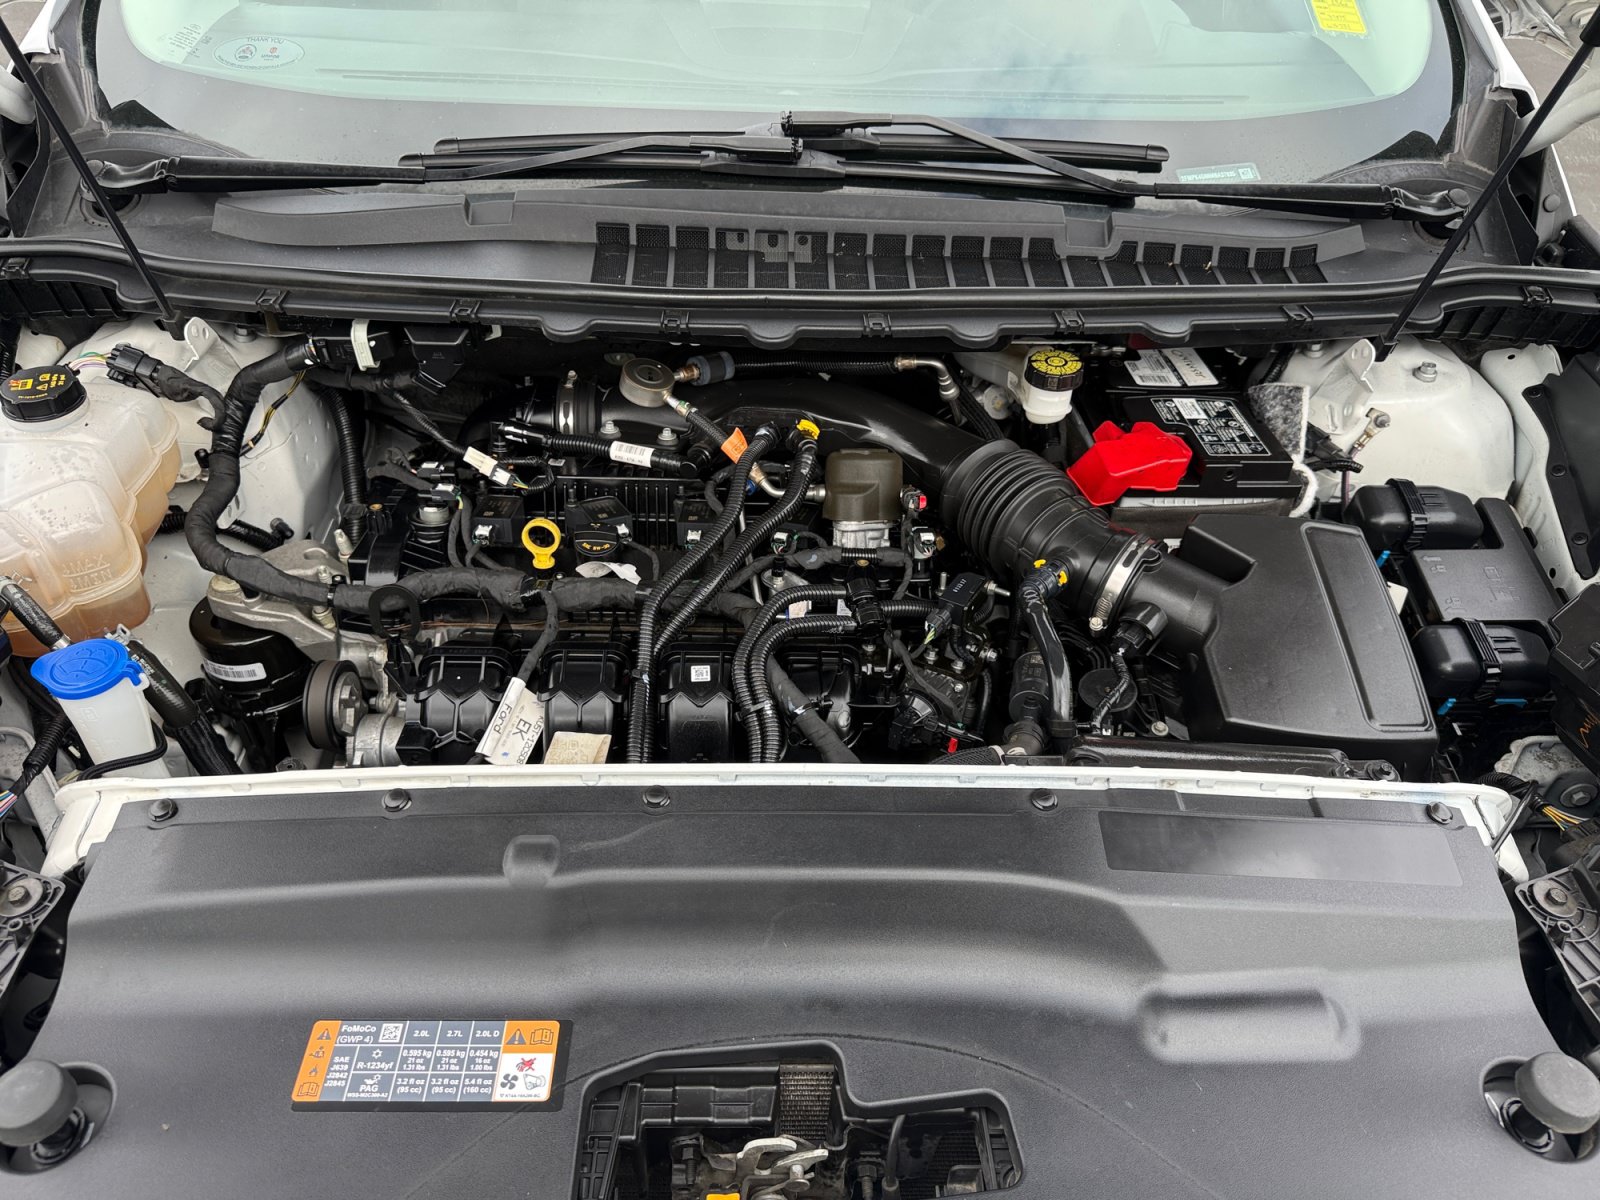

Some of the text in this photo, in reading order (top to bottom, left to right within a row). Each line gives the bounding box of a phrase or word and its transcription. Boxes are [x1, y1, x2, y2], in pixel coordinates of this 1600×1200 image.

[70, 554, 107, 574] MAX
[77, 568, 112, 589] MIN
[494, 703, 512, 734] Ford
[512, 718, 532, 742] EK
[337, 1035, 373, 1044] (GWP 4)
[402, 1049, 432, 1058] 0.595 kg
[436, 1049, 465, 1058] 0.595 kg
[469, 1049, 499, 1058] 0.454 kg
[357, 1062, 393, 1070] R-1234yf
[359, 1084, 378, 1092] PAG
[397, 1086, 422, 1094] (95 cc)
[431, 1086, 456, 1094] (95 cc)
[463, 1086, 492, 1094] (160 cc)
